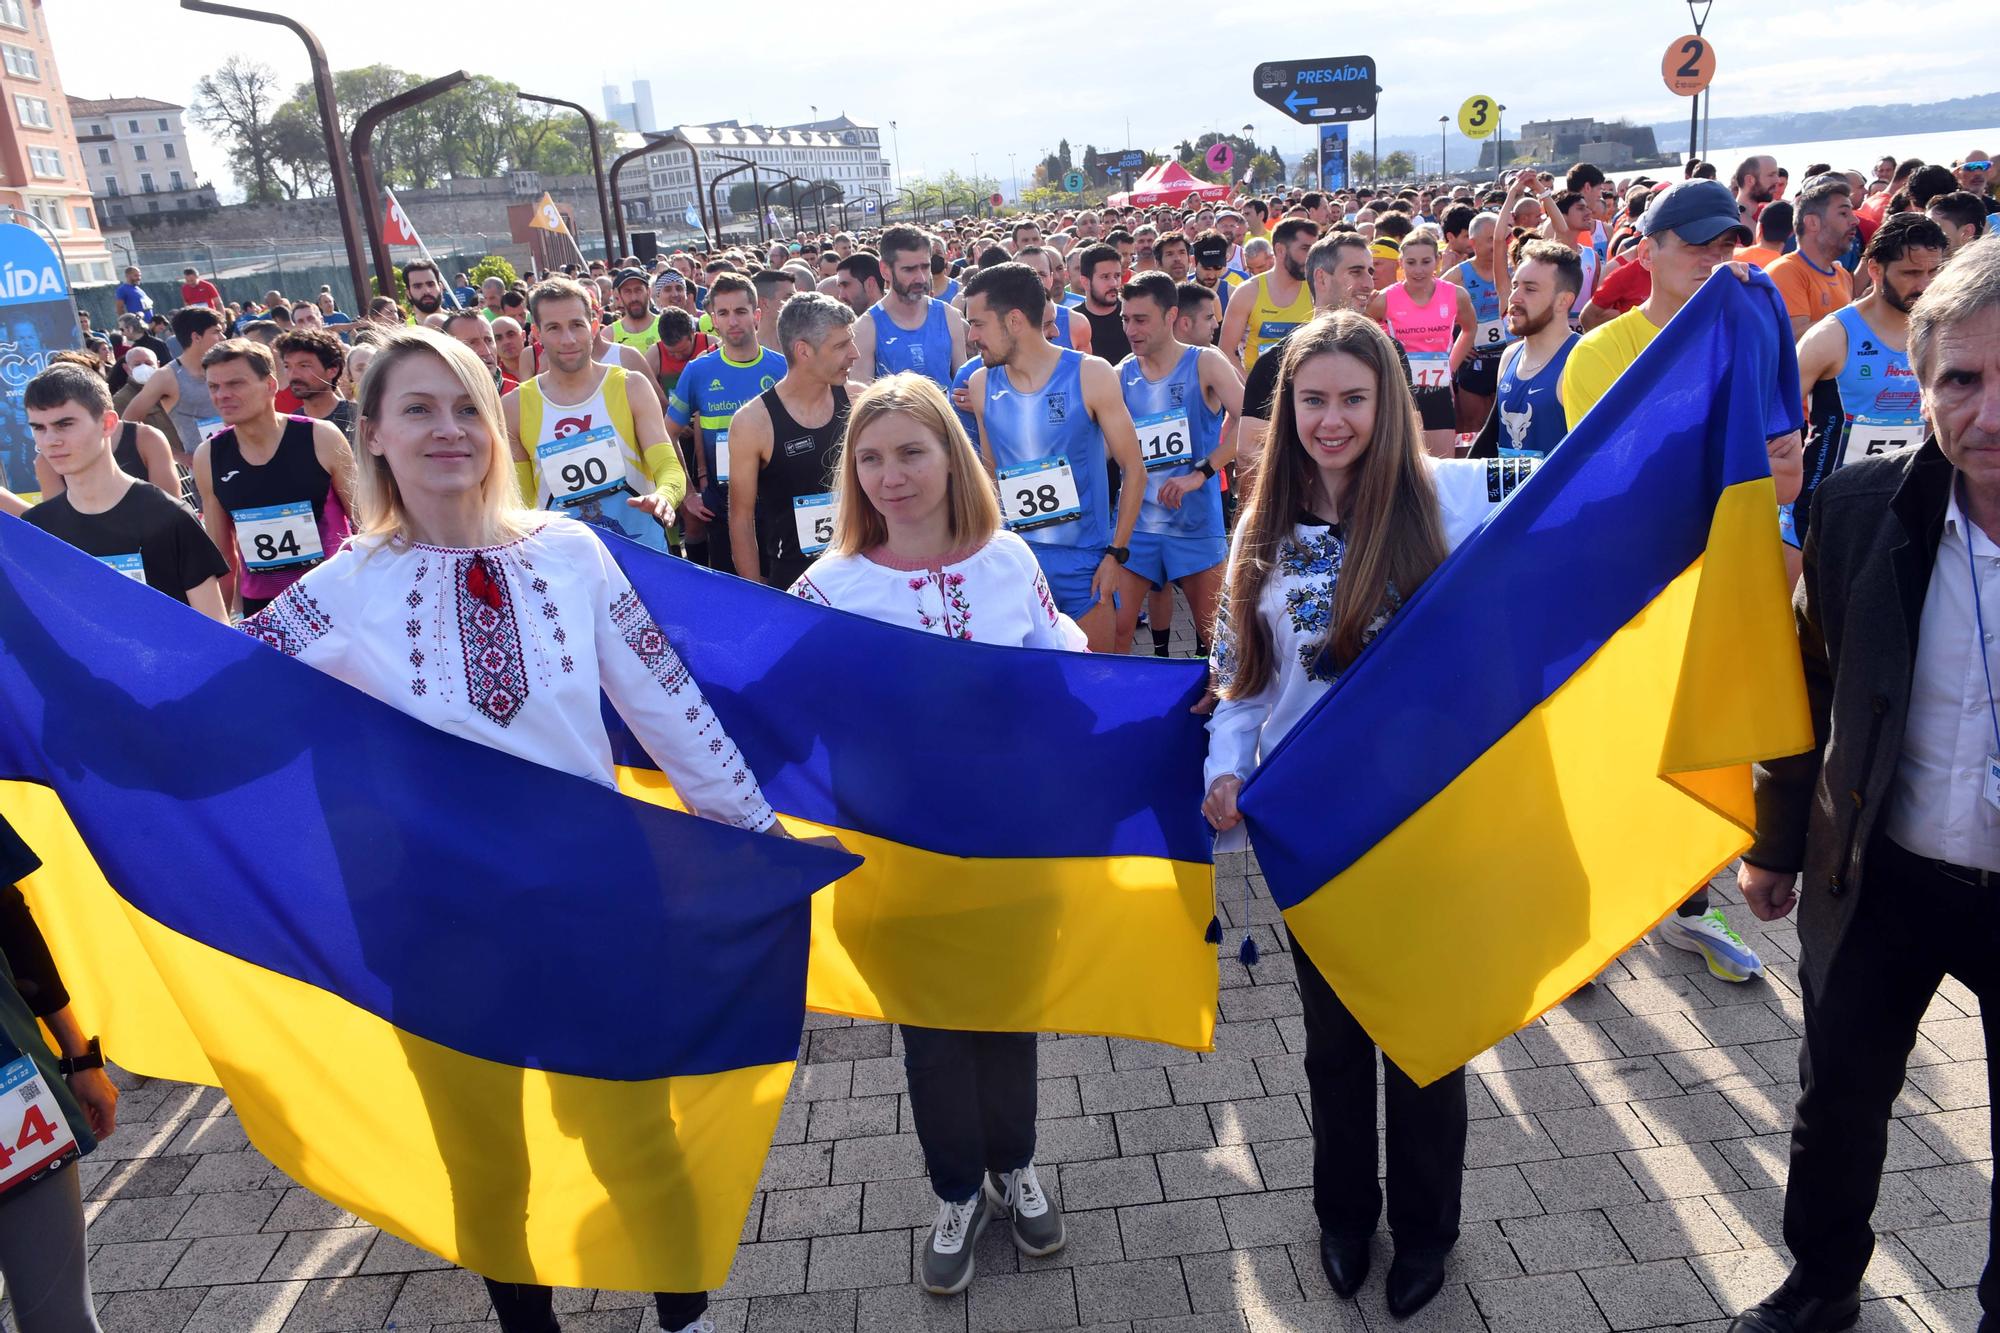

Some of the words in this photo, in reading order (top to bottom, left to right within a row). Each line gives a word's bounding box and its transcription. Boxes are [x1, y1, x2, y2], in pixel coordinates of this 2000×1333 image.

[1677, 39, 1704, 77] 2
[1296, 64, 1369, 84] PRESAÍDA
[1469, 99, 1489, 127] 3
[1122, 151, 1143, 161] SAÍDA
[1213, 146, 1228, 165] 4
[1069, 175, 1079, 189] 5
[543, 204, 559, 229] 3
[866, 201, 874, 214] P
[1488, 327, 1501, 343] 8
[1416, 368, 1445, 389] 17
[560, 457, 608, 492] 90
[1015, 484, 1061, 518] 38
[253, 529, 301, 561] 84
